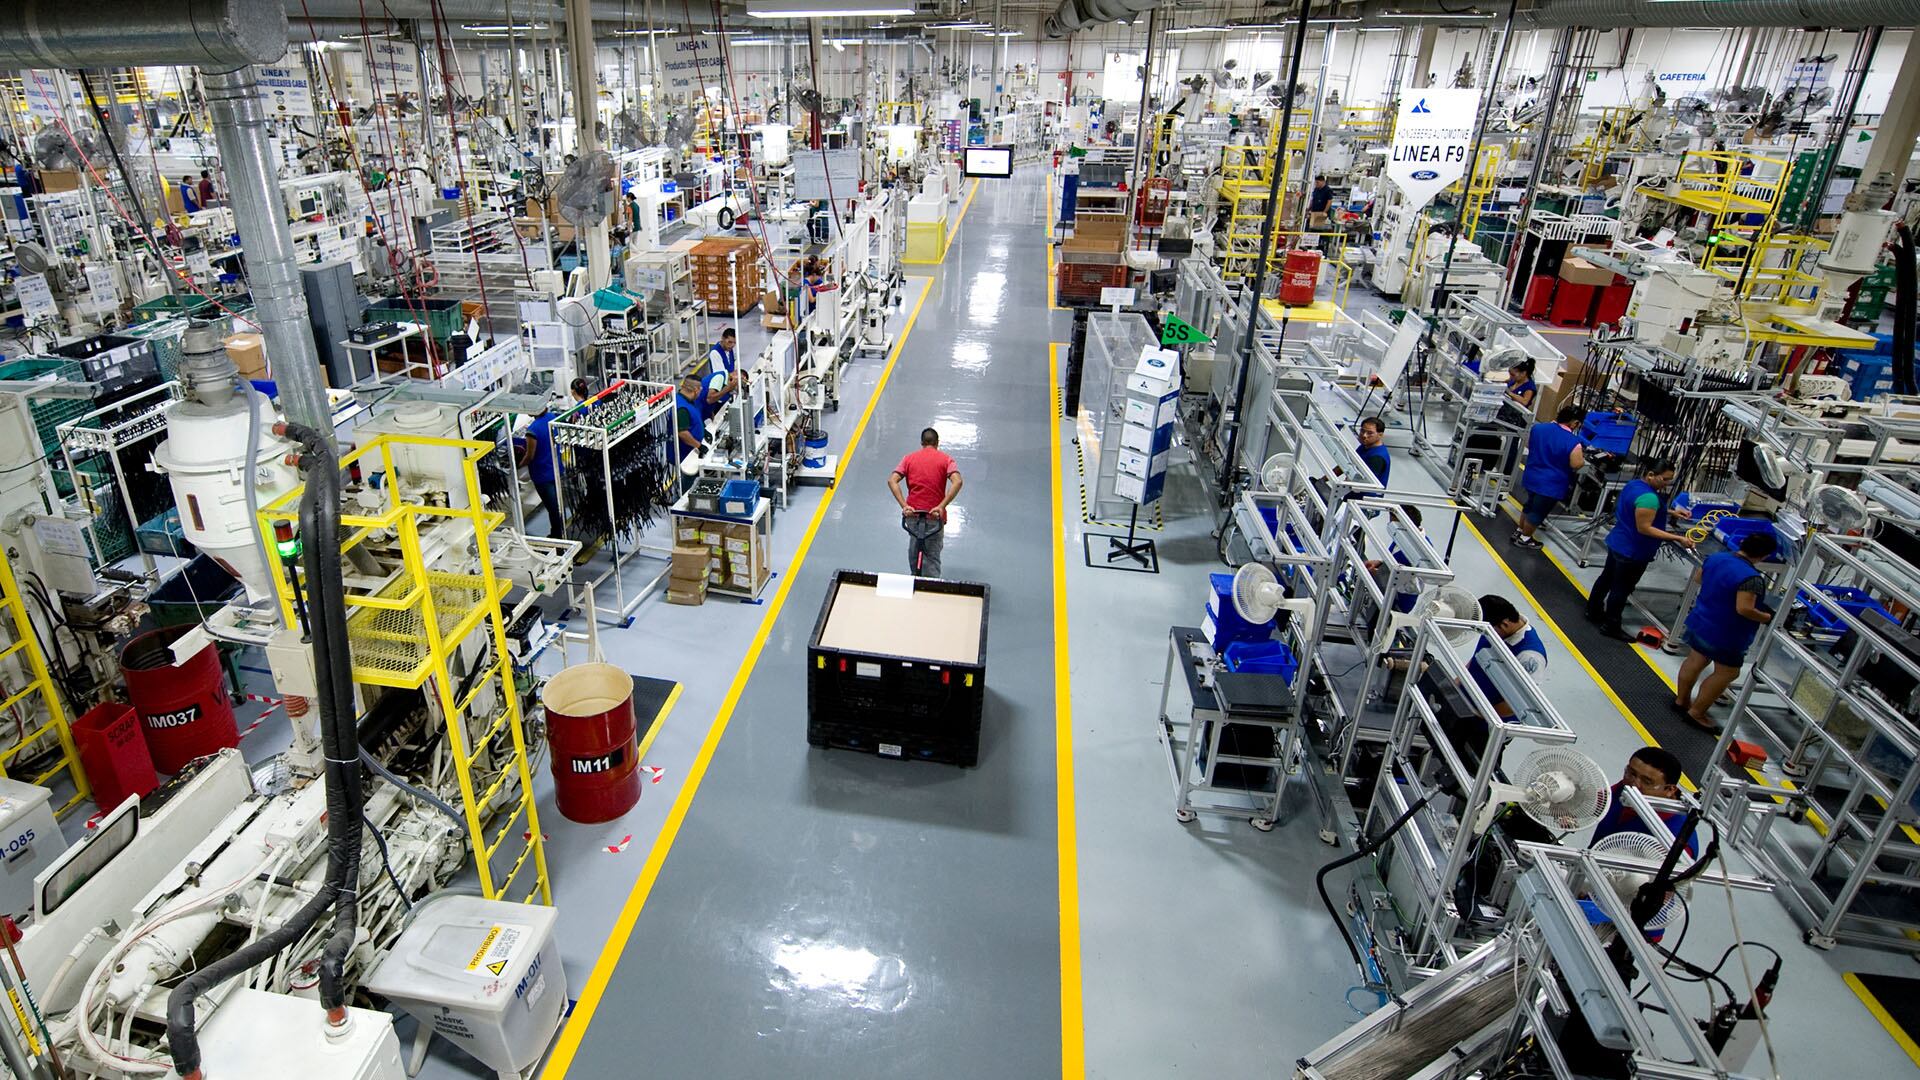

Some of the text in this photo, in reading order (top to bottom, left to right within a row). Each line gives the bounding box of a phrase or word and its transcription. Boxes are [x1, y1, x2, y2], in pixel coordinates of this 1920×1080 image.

[675, 40, 708, 52] LINEA N
[261, 69, 283, 77] LINEA
[1659, 73, 1706, 81] CAFETERIA
[1393, 145, 1464, 162] LINEA F9
[1166, 323, 1189, 340] 5S
[148, 708, 196, 728] IM037
[471, 929, 498, 966] PROHIBIDO
[433, 1014, 464, 1025] PLASTIC
